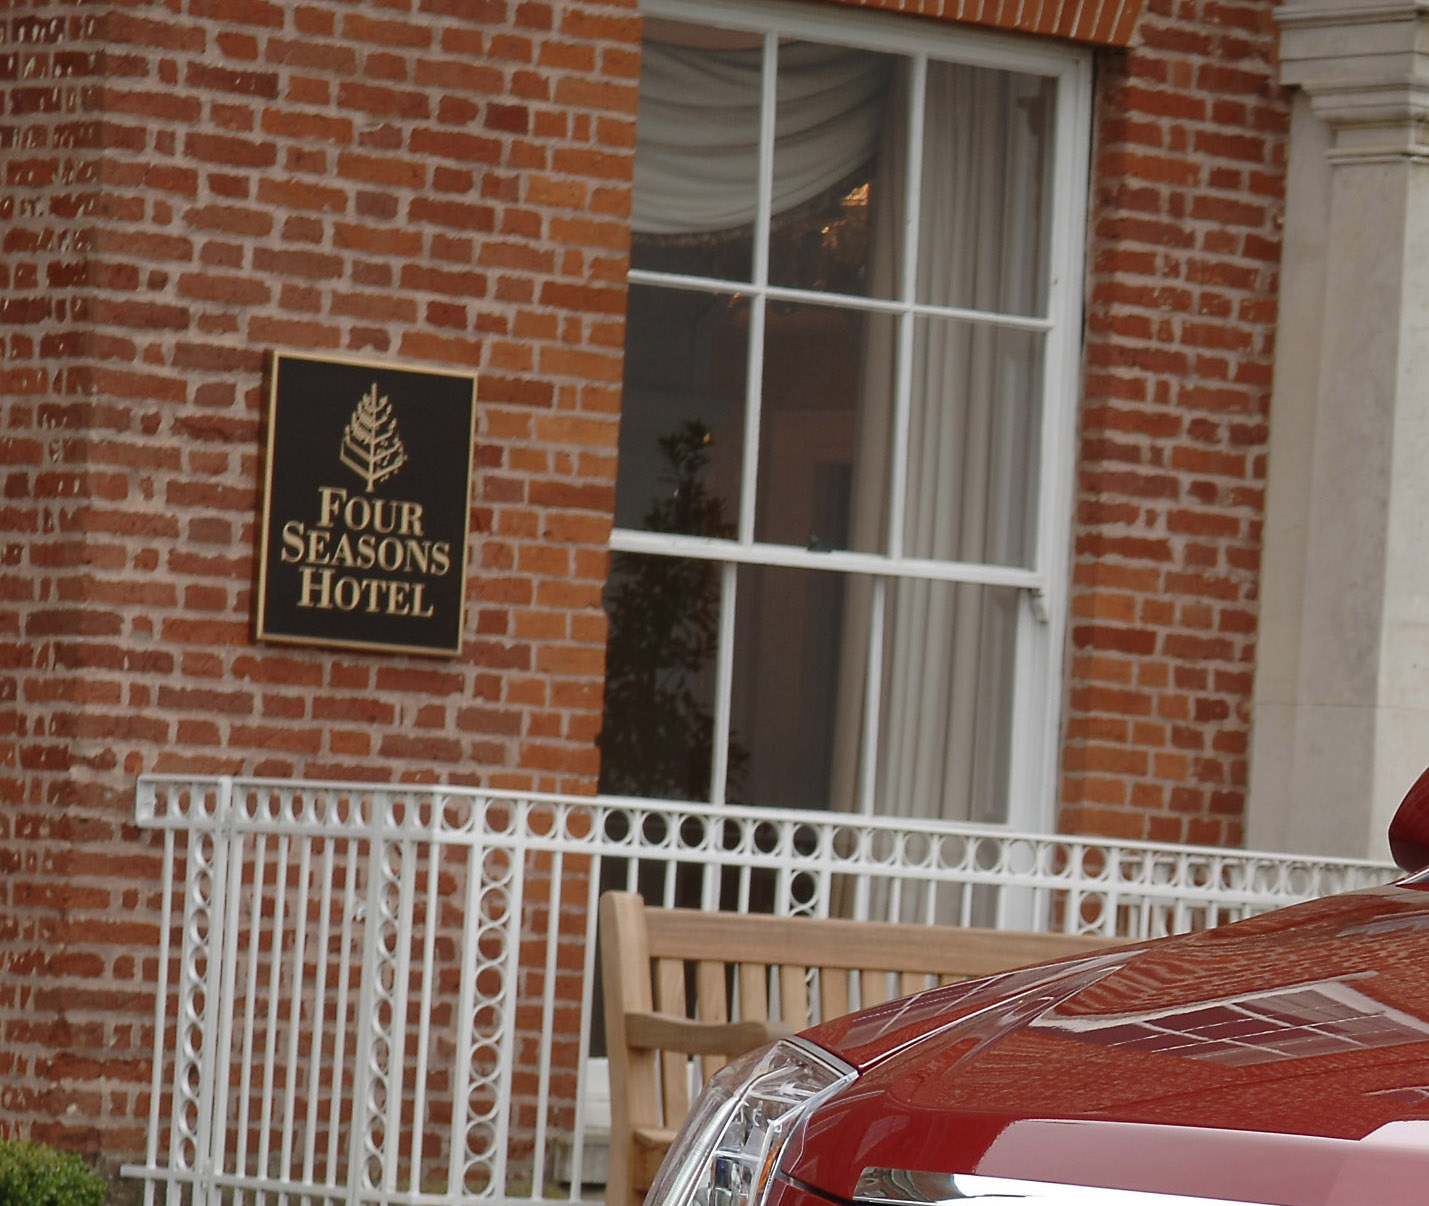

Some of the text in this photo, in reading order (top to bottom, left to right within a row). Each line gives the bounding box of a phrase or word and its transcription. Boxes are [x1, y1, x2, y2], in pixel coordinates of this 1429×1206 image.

[317, 486, 424, 537] FOUR
[280, 520, 452, 576] SEASONS
[297, 566, 434, 618] HOTEL
